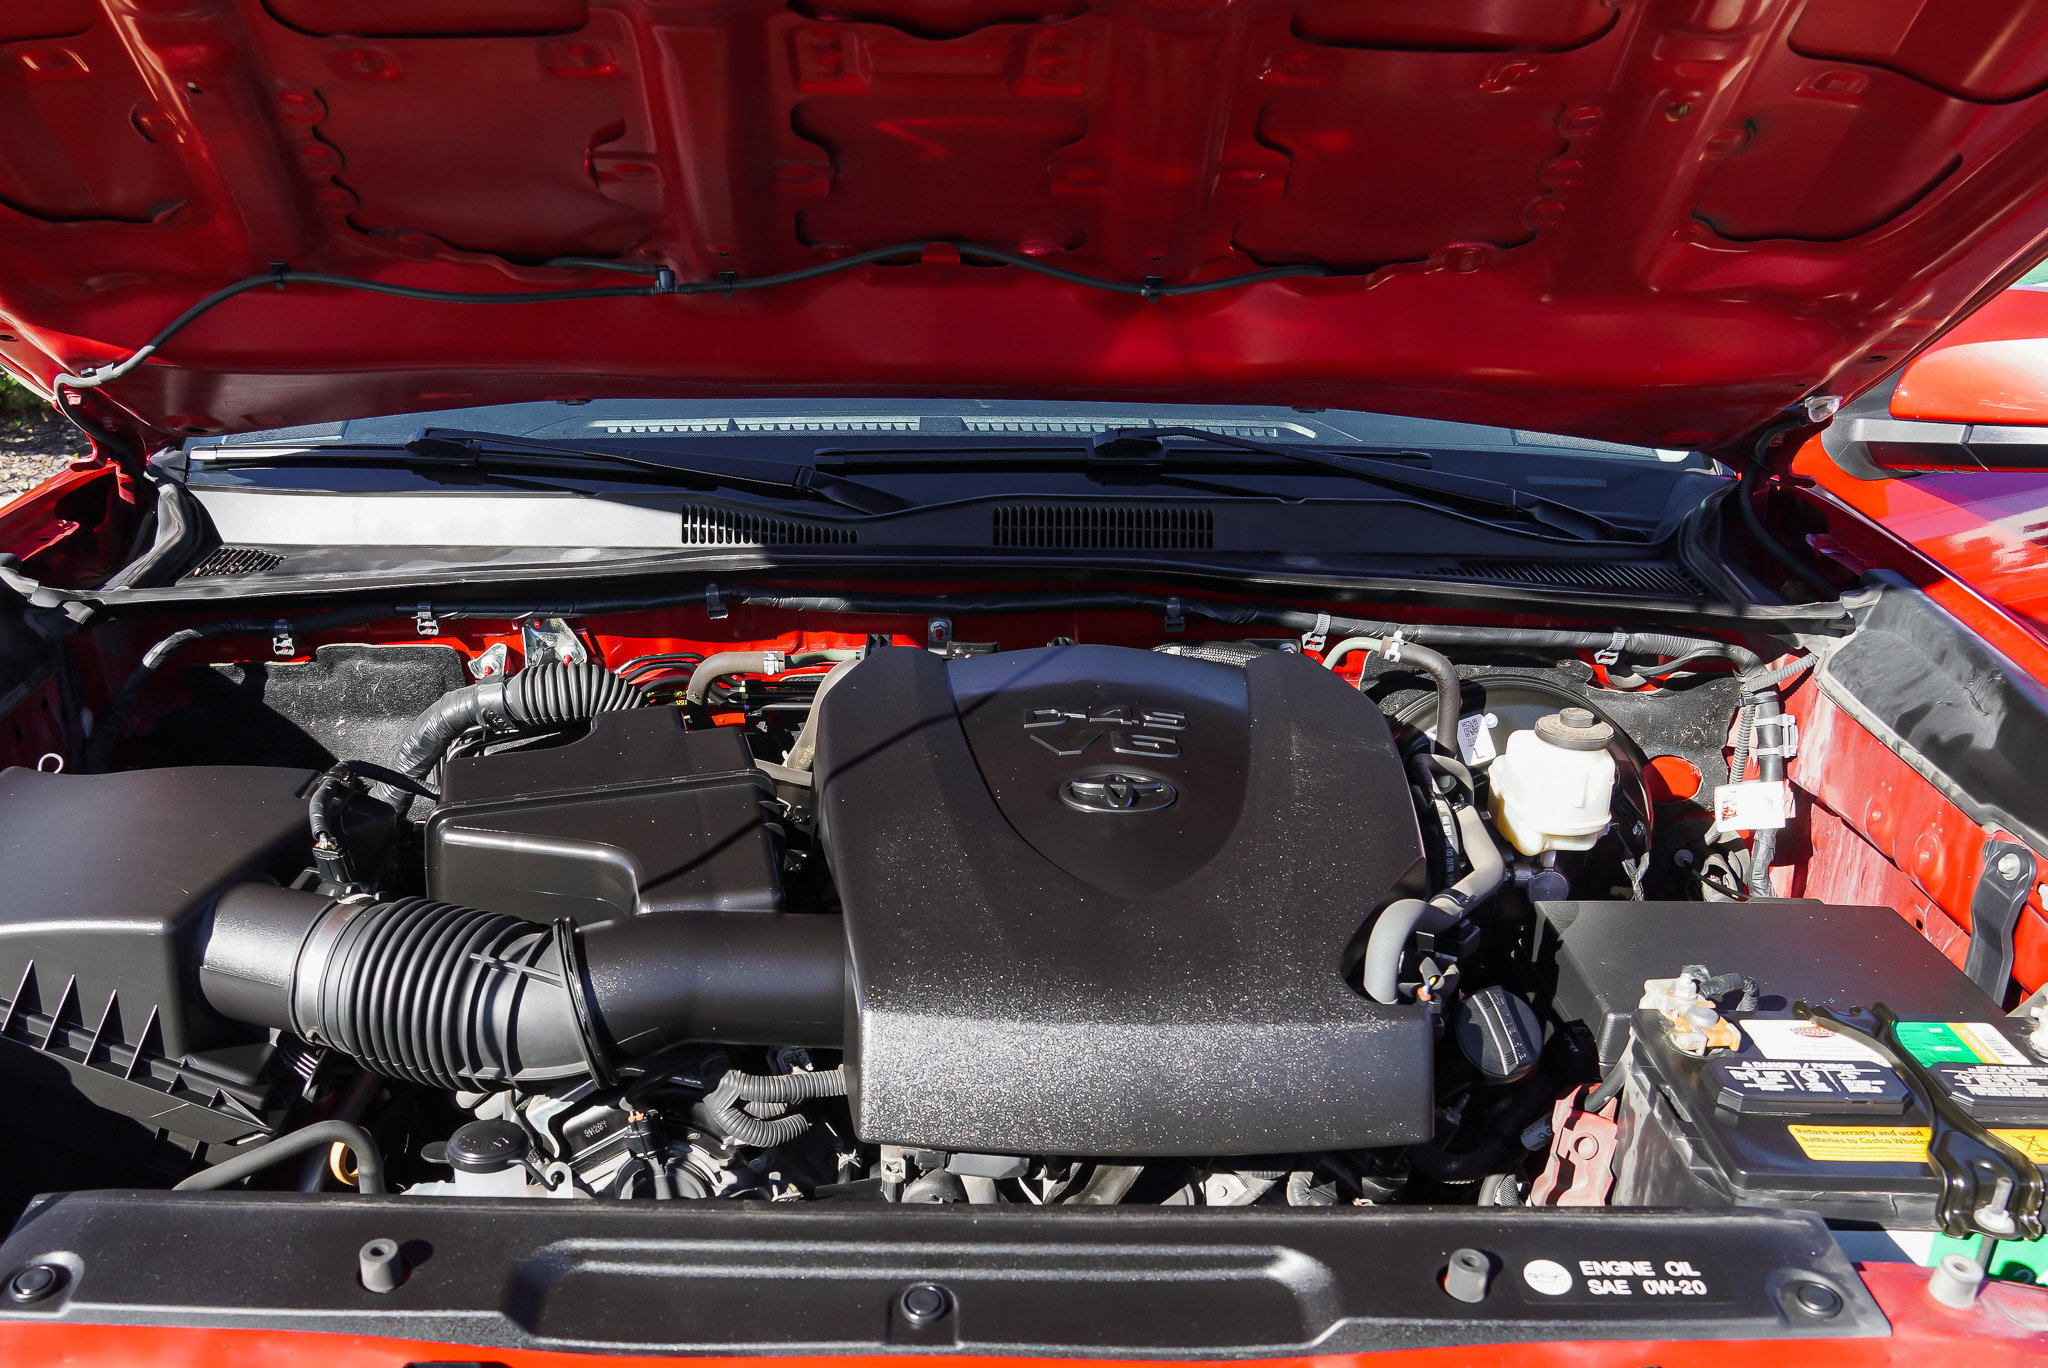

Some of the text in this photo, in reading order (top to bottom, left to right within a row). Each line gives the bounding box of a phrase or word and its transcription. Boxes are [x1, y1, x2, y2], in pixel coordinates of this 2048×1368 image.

[1795, 1127, 1831, 1136] Return
[1831, 1129, 1876, 1138] warranty
[1878, 1129, 1897, 1137] and
[1802, 1136, 1847, 1144] batteries
[1847, 1137, 1858, 1145] to
[1860, 1137, 1893, 1145] Costco
[1579, 1260, 1702, 1278] ENGINE OIL
[1587, 1279, 1708, 1296] SAE 0W-20
